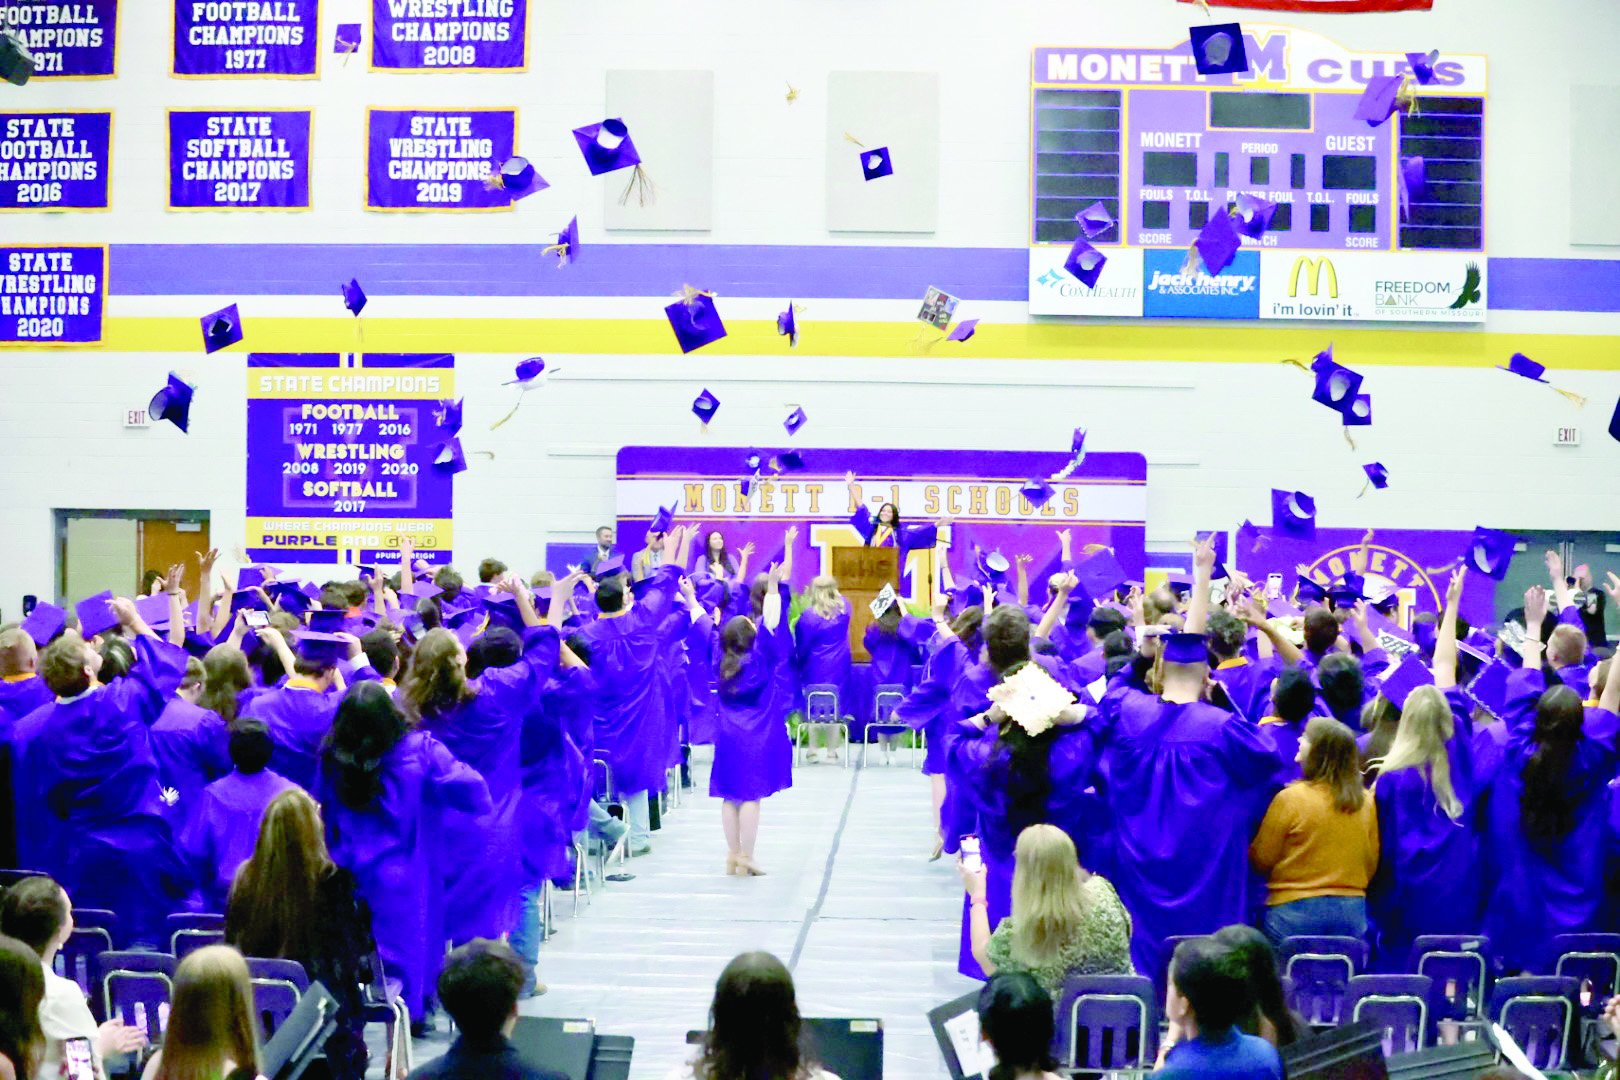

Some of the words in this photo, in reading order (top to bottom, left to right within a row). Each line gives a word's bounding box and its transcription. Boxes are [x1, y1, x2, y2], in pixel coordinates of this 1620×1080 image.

[192, 2, 301, 22] FOOTBALL
[388, 0, 514, 18] WRESTLING
[2, 28, 103, 48] AMPIONS
[188, 25, 304, 45] CHAMPIONS
[391, 21, 511, 41] CHAMPIONS
[33, 52, 63, 71] 971
[225, 49, 267, 69] 1977
[423, 45, 476, 66] 2008
[6, 118, 75, 138] STATE
[206, 116, 272, 136] STATE
[410, 116, 472, 137] STATE
[0, 139, 93, 160] OOTBALL
[186, 138, 290, 158] SOFTBALL
[388, 138, 493, 159] WRESTLING
[1140, 132, 1203, 149] MONETT
[1241, 142, 1279, 155] PERIOD
[1325, 135, 1376, 152] GUEST
[0, 160, 97, 181] HAMPIONS
[182, 160, 295, 181] CHAMPIONS
[388, 159, 493, 181] CHAMPIONS
[16, 182, 62, 203] 2016
[214, 181, 261, 202] 2017
[416, 181, 462, 203] 2019
[1139, 189, 1173, 201] FOULS
[1184, 189, 1214, 202] T.O.L.
[1268, 191, 1296, 203] FOUL
[1306, 191, 1335, 203] T.O.L.
[1345, 192, 1380, 204] FOULS
[1138, 233, 1173, 244] SCORE
[1345, 237, 1379, 248] SCORE
[8, 252, 73, 272] STATE
[1148, 271, 1194, 290] jack
[1196, 271, 1256, 292] henry
[1167, 286, 1220, 295] ASSOCIATES
[1374, 281, 1450, 294] FREEDOM
[1, 295, 90, 315] HAMPIONS
[1272, 302, 1294, 316] i'm
[1299, 302, 1339, 316] lovin'
[1342, 304, 1353, 317] it
[17, 317, 64, 337] 2020
[260, 375, 323, 392] STATE
[328, 375, 441, 393] CHAMPIONS
[128, 410, 146, 425] EXIT
[301, 404, 400, 420] FOOTBALL
[289, 423, 318, 435] 1971
[332, 423, 363, 435] 1977
[378, 423, 411, 436] 2016
[1558, 427, 1577, 443] EXIT
[297, 443, 405, 460] WRESTLING
[282, 462, 319, 474] 2008
[333, 462, 367, 475] 2019
[381, 462, 419, 475] 2020
[302, 481, 398, 498] SOFTBALL
[683, 484, 824, 513] MONETT
[333, 500, 366, 513] 2017
[263, 521, 311, 531] WHERE
[313, 521, 393, 532] CHAMPIONS
[395, 522, 434, 532] WEAR
[262, 535, 338, 546] PURPLE
[342, 535, 380, 546] AND
[375, 551, 436, 560] #PURPREIGN
